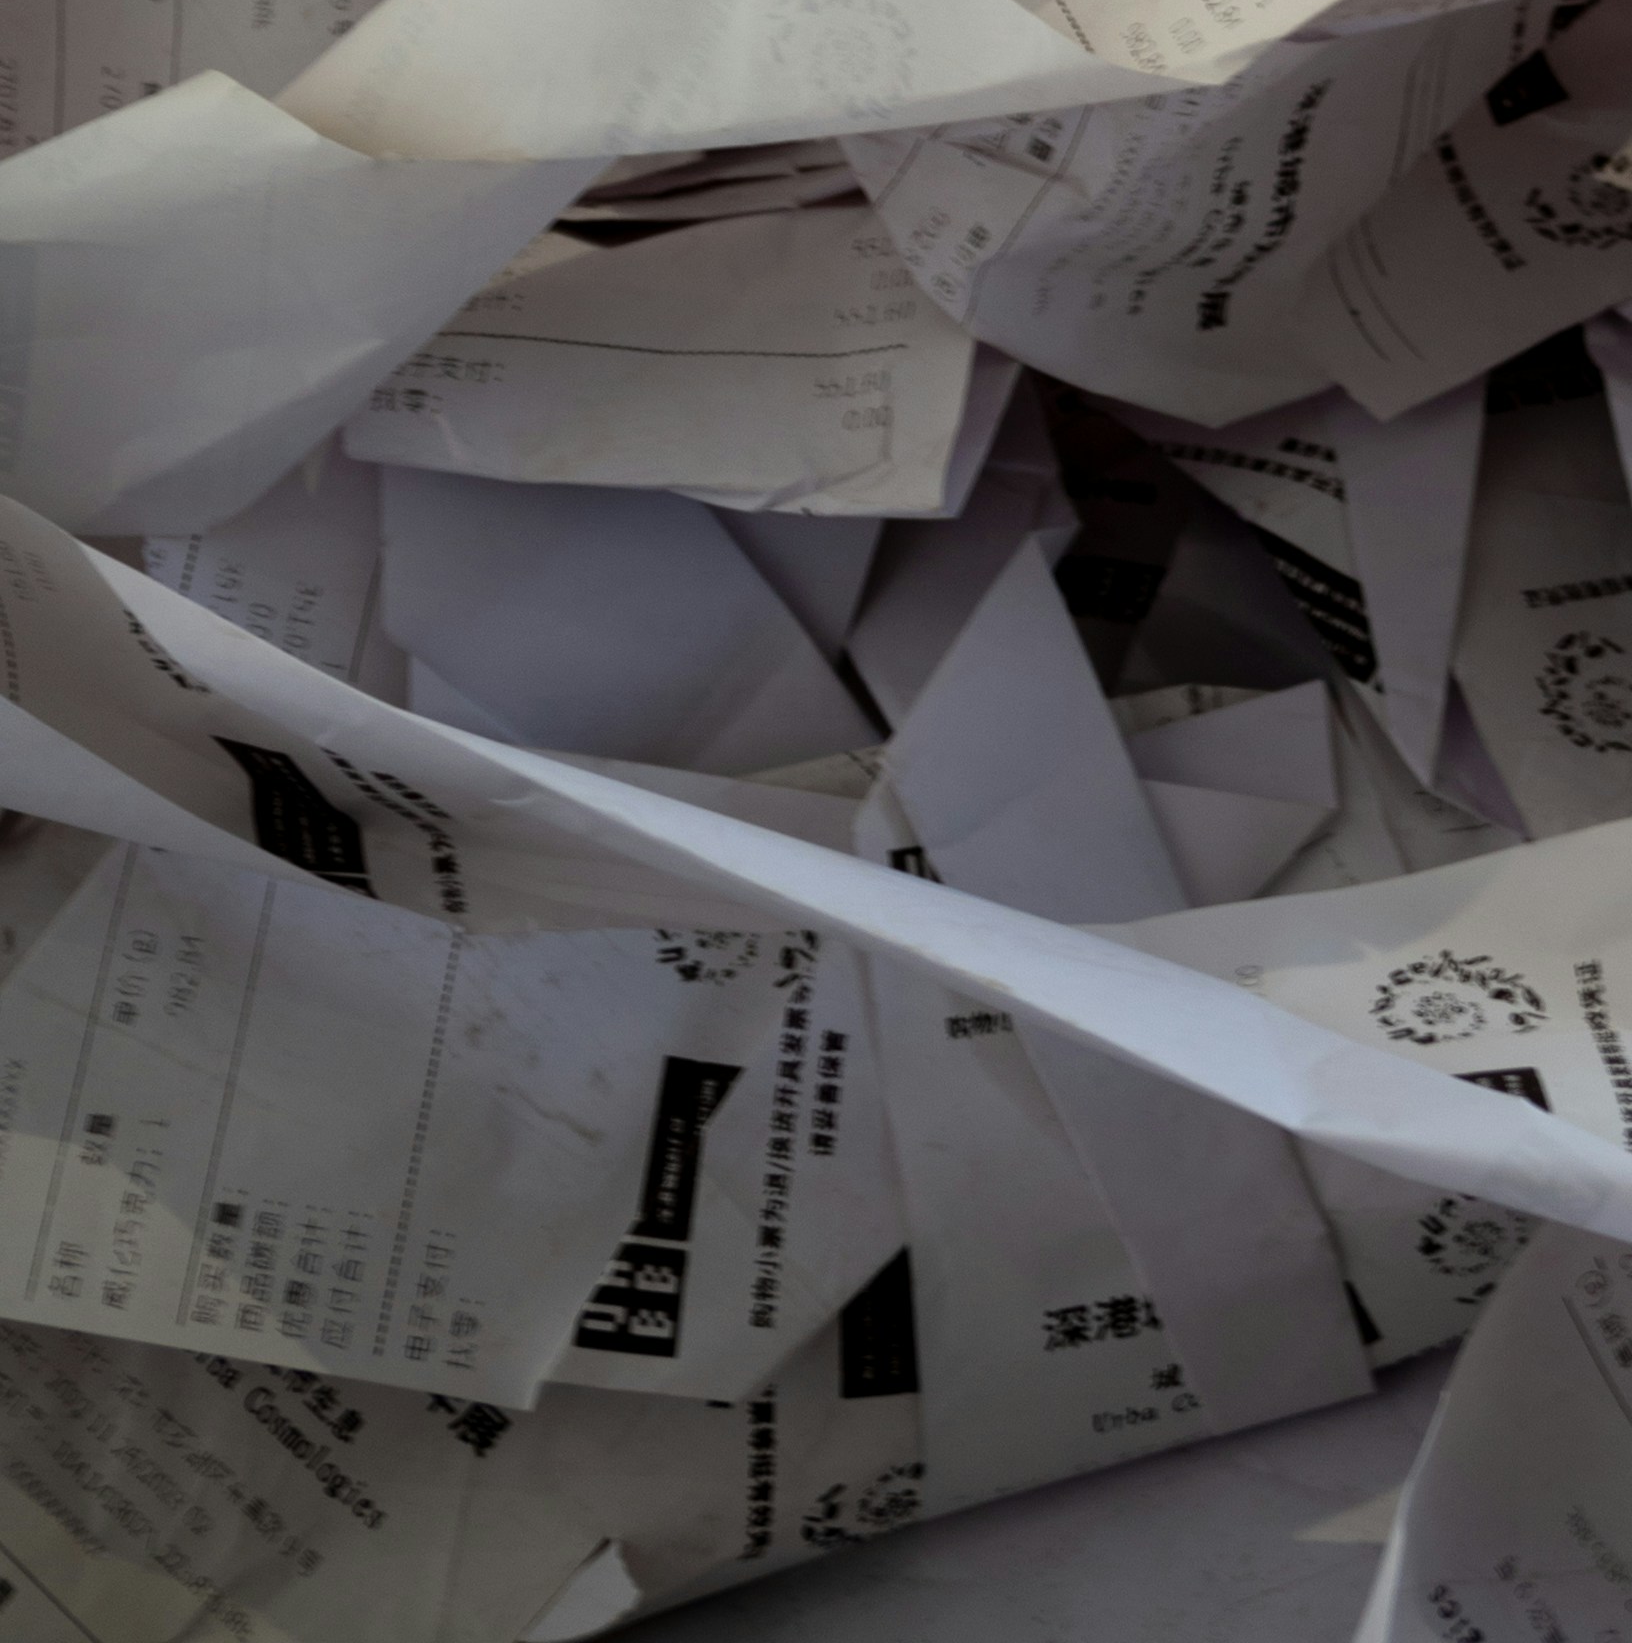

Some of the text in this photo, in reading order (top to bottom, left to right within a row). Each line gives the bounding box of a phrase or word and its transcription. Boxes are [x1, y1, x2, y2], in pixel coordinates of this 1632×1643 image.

[807, 1028, 850, 1157] 请妥善保管
[236, 1380, 395, 1539] Cosmologies
